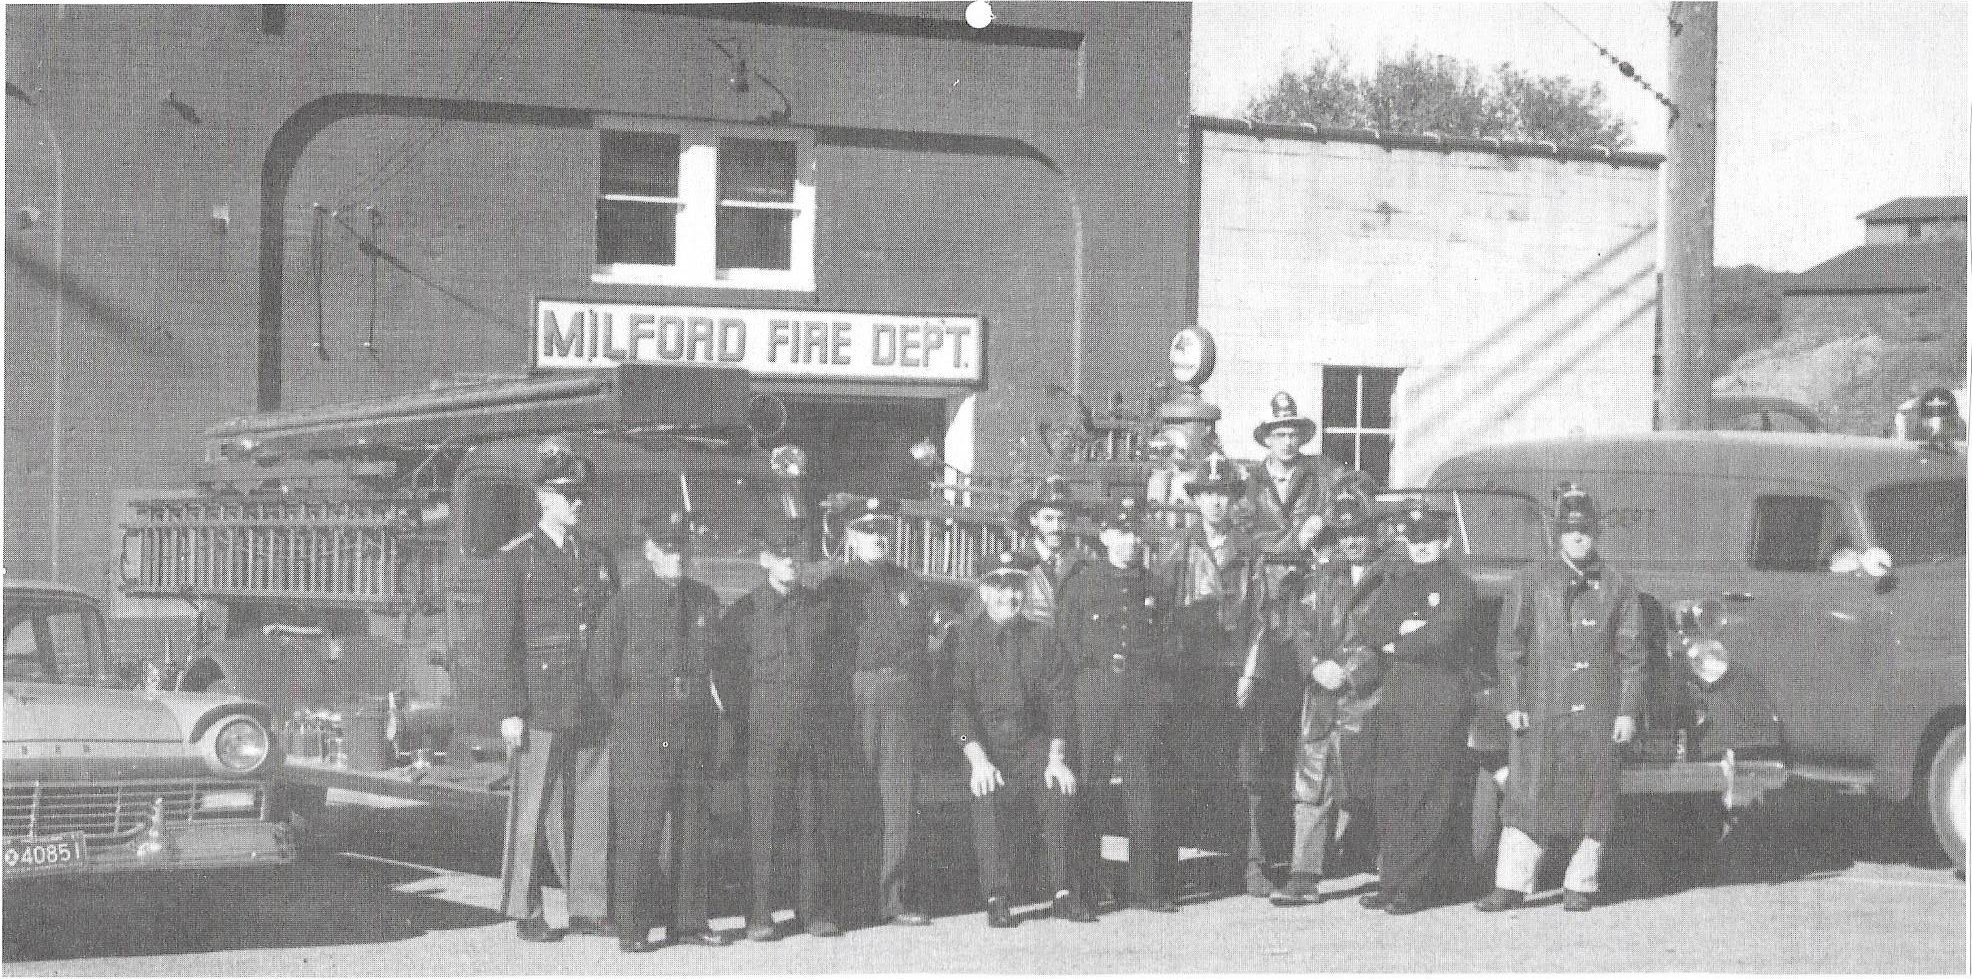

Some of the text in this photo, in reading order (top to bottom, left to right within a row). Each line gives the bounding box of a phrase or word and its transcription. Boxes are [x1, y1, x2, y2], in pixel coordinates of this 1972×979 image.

[543, 309, 972, 368] MILFORD FIRE DEPT.
